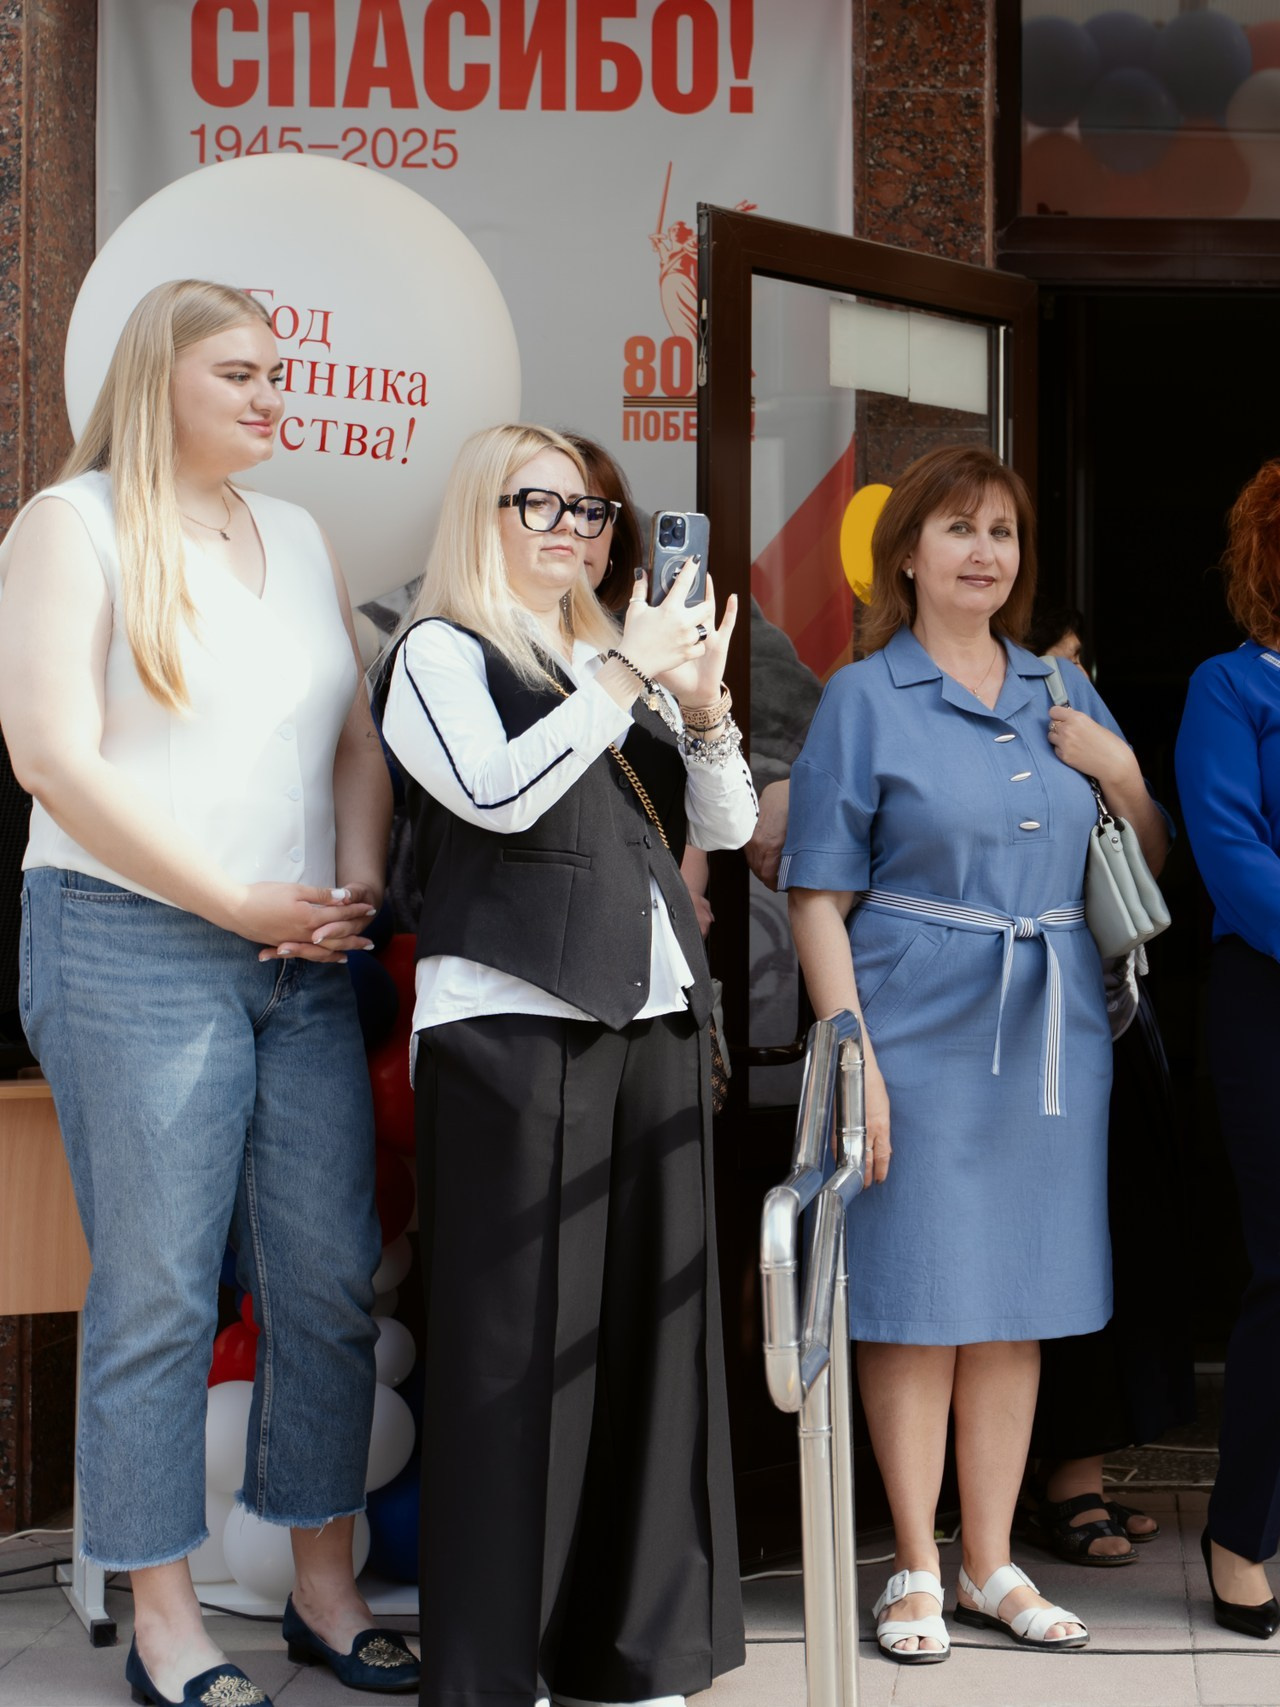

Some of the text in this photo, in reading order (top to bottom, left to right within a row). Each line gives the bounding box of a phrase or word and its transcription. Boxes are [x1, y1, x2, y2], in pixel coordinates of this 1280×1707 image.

[190, 0, 755, 115] СПАСИБО!
[280, 356, 430, 407] тника
[623, 335, 694, 397] 80
[279, 415, 416, 465] ства!
